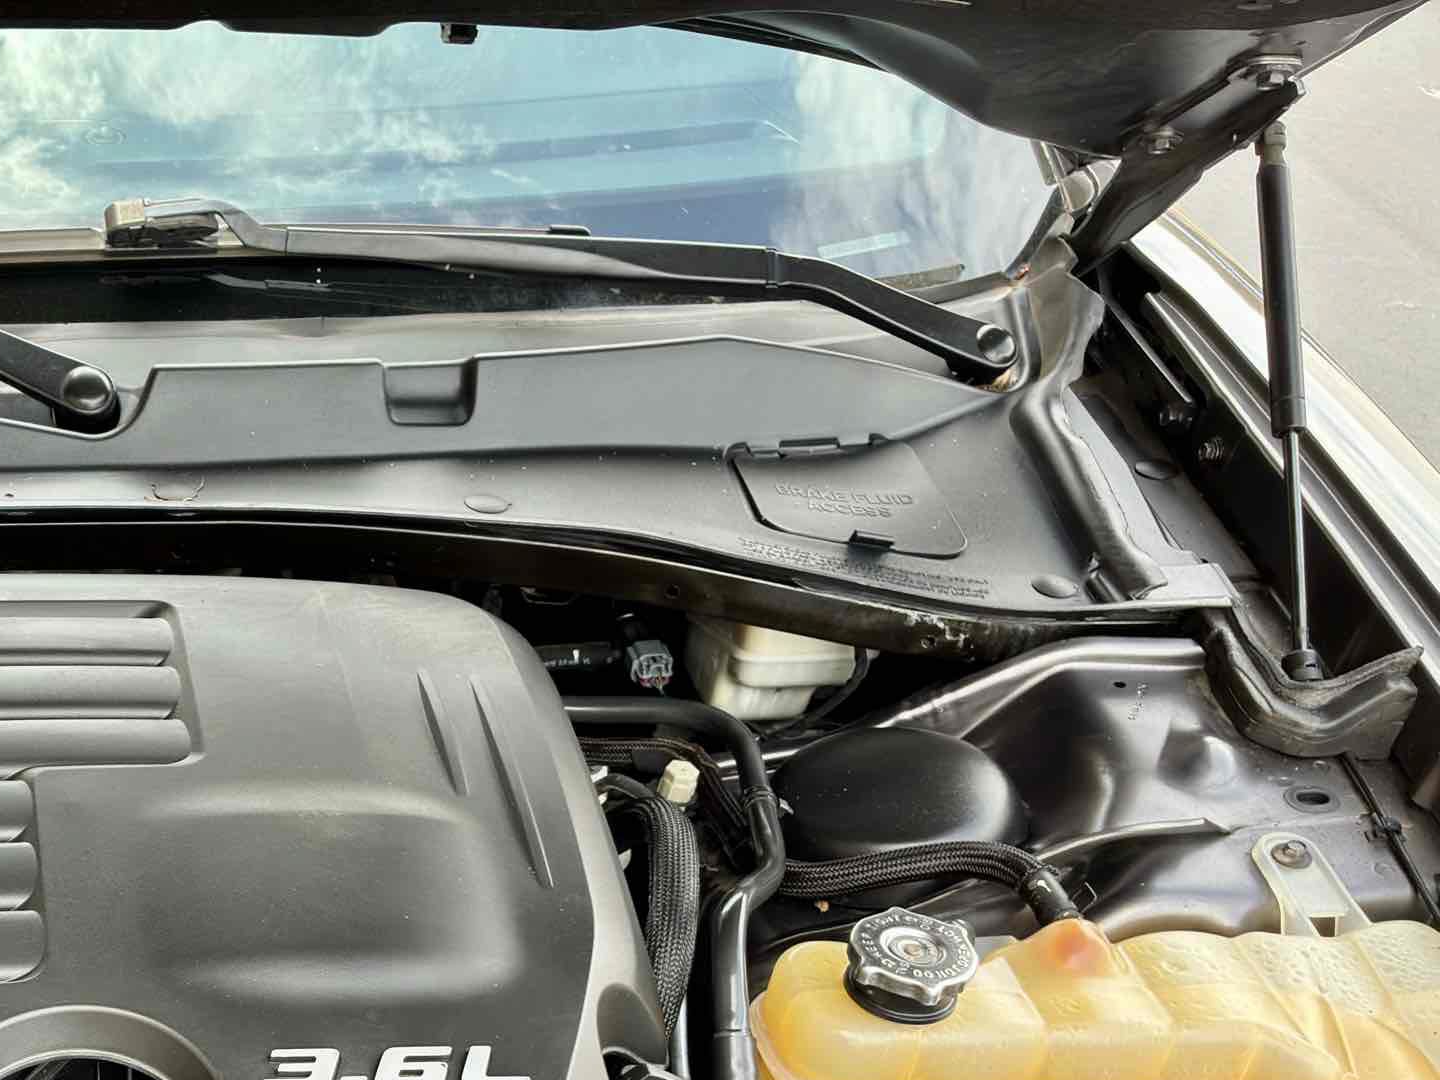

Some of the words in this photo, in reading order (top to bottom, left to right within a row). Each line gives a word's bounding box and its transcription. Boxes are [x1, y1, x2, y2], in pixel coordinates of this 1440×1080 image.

[775, 481, 848, 502] BRAKE
[851, 488, 914, 505] FLUID
[808, 498, 892, 518] ACCESS
